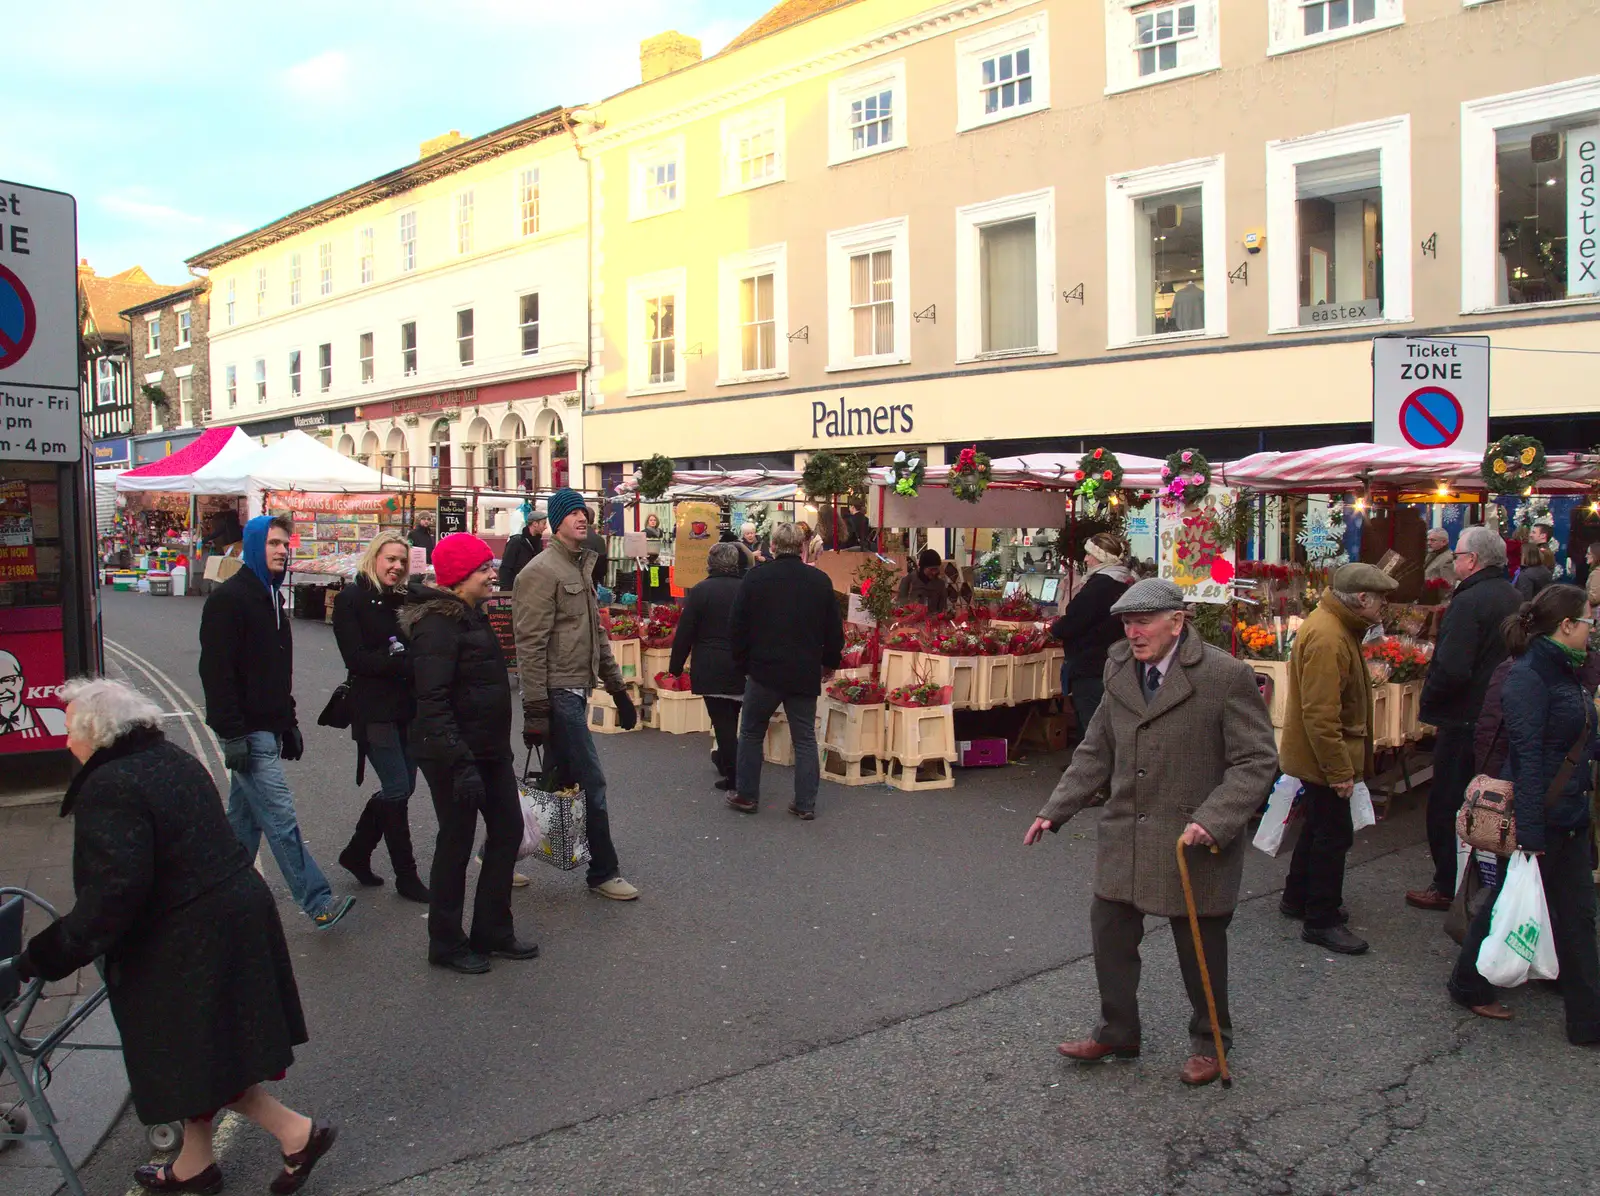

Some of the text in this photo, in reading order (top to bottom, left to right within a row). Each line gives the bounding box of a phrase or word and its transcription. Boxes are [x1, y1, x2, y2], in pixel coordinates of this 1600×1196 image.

[1579, 140, 1596, 282] eastex
[1312, 305, 1367, 322] eastex
[1406, 344, 1458, 357] Ticket
[1400, 363, 1462, 380] ZONE
[48, 396, 69, 410] Fri
[812, 396, 913, 438] Palmers
[25, 438, 37, 452] 4
[42, 441, 66, 455] pm
[445, 516, 460, 525] TEA
